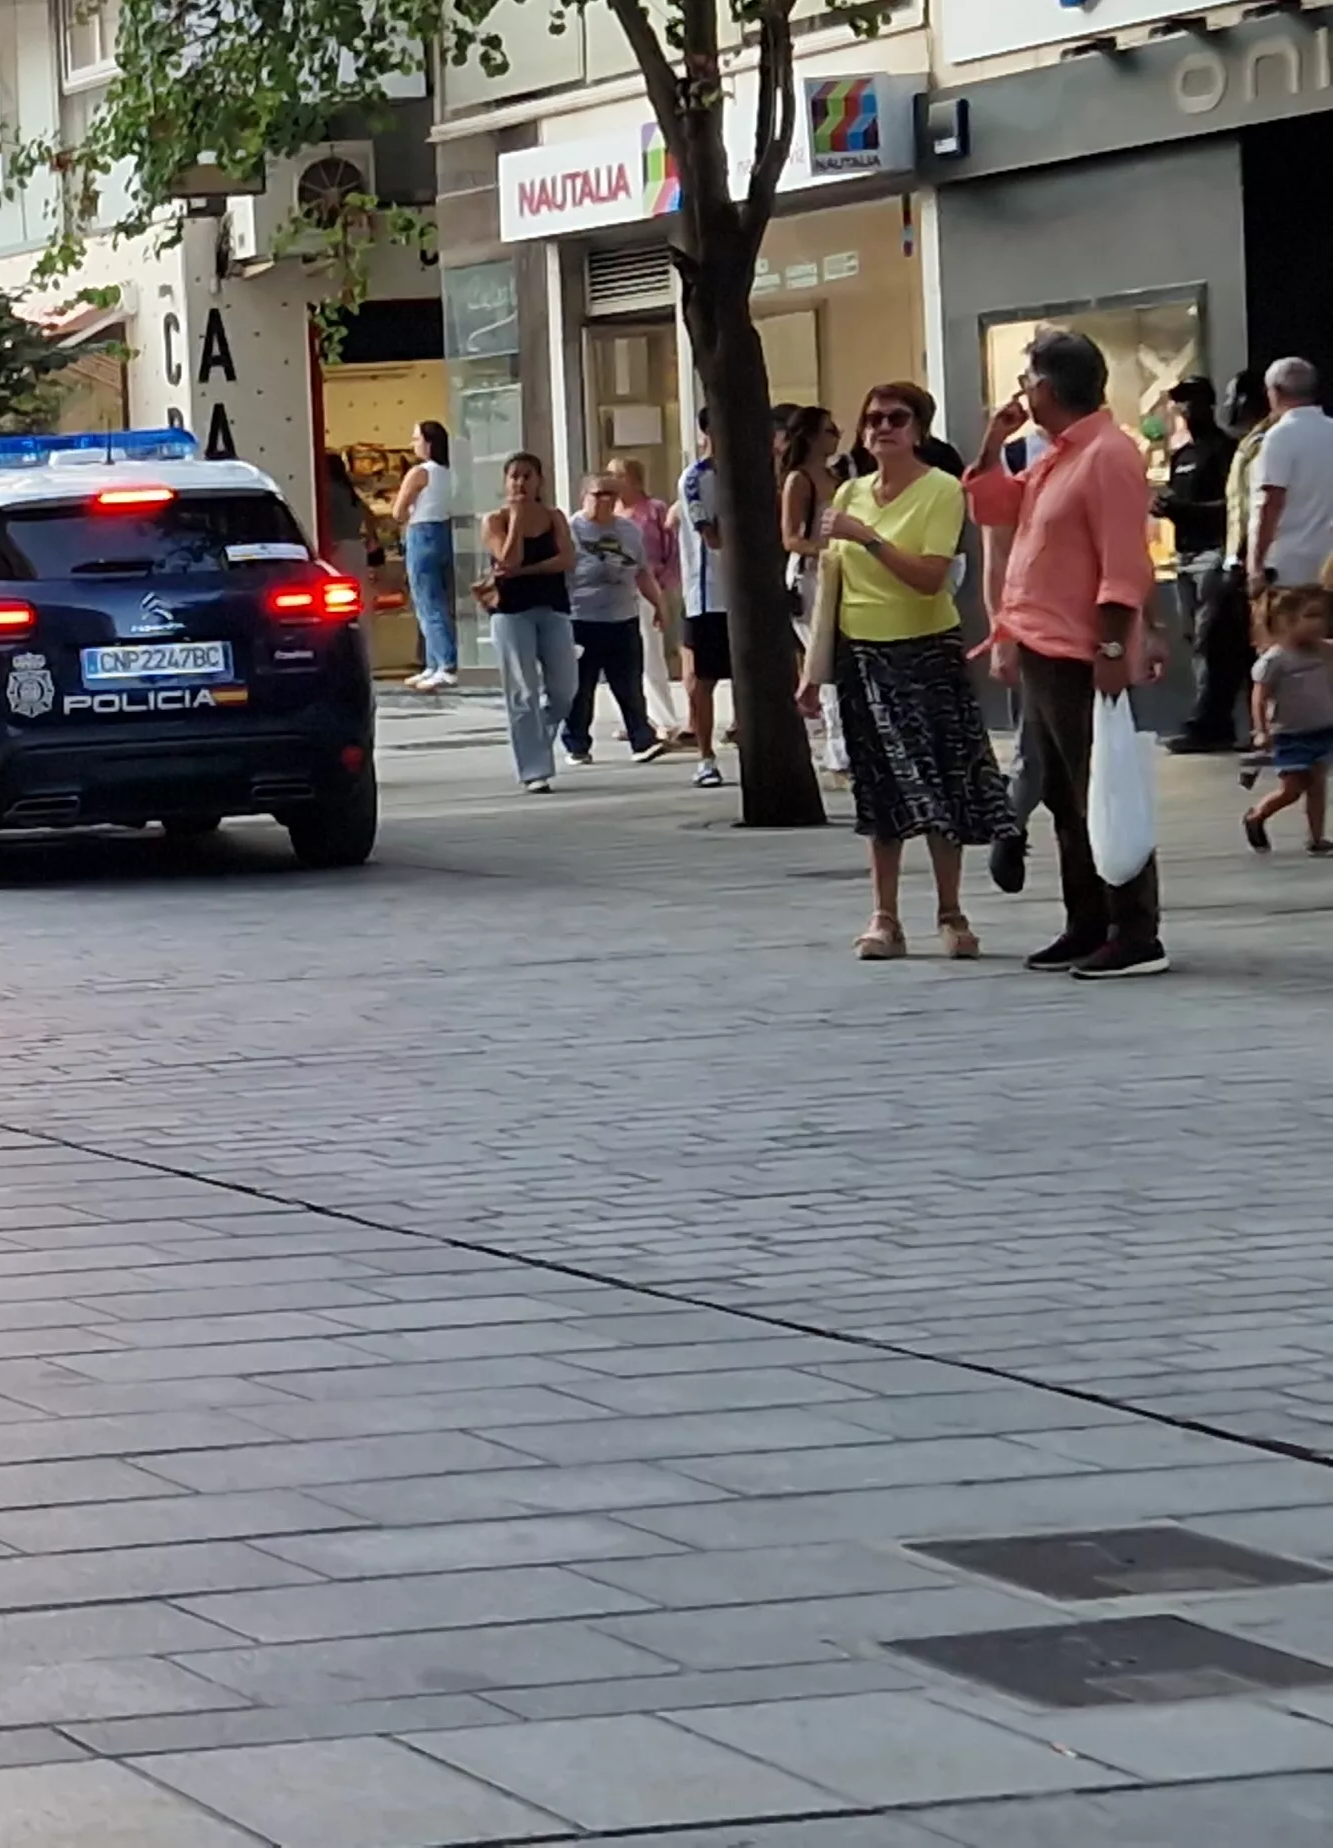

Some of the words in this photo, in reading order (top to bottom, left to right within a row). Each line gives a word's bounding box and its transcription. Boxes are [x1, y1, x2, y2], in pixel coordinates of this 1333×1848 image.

[815, 154, 882, 172] NAUTALIA
[518, 162, 632, 217] NAUTALIA
[99, 646, 222, 674] CNP2247BC
[63, 687, 217, 716] POLICIA
